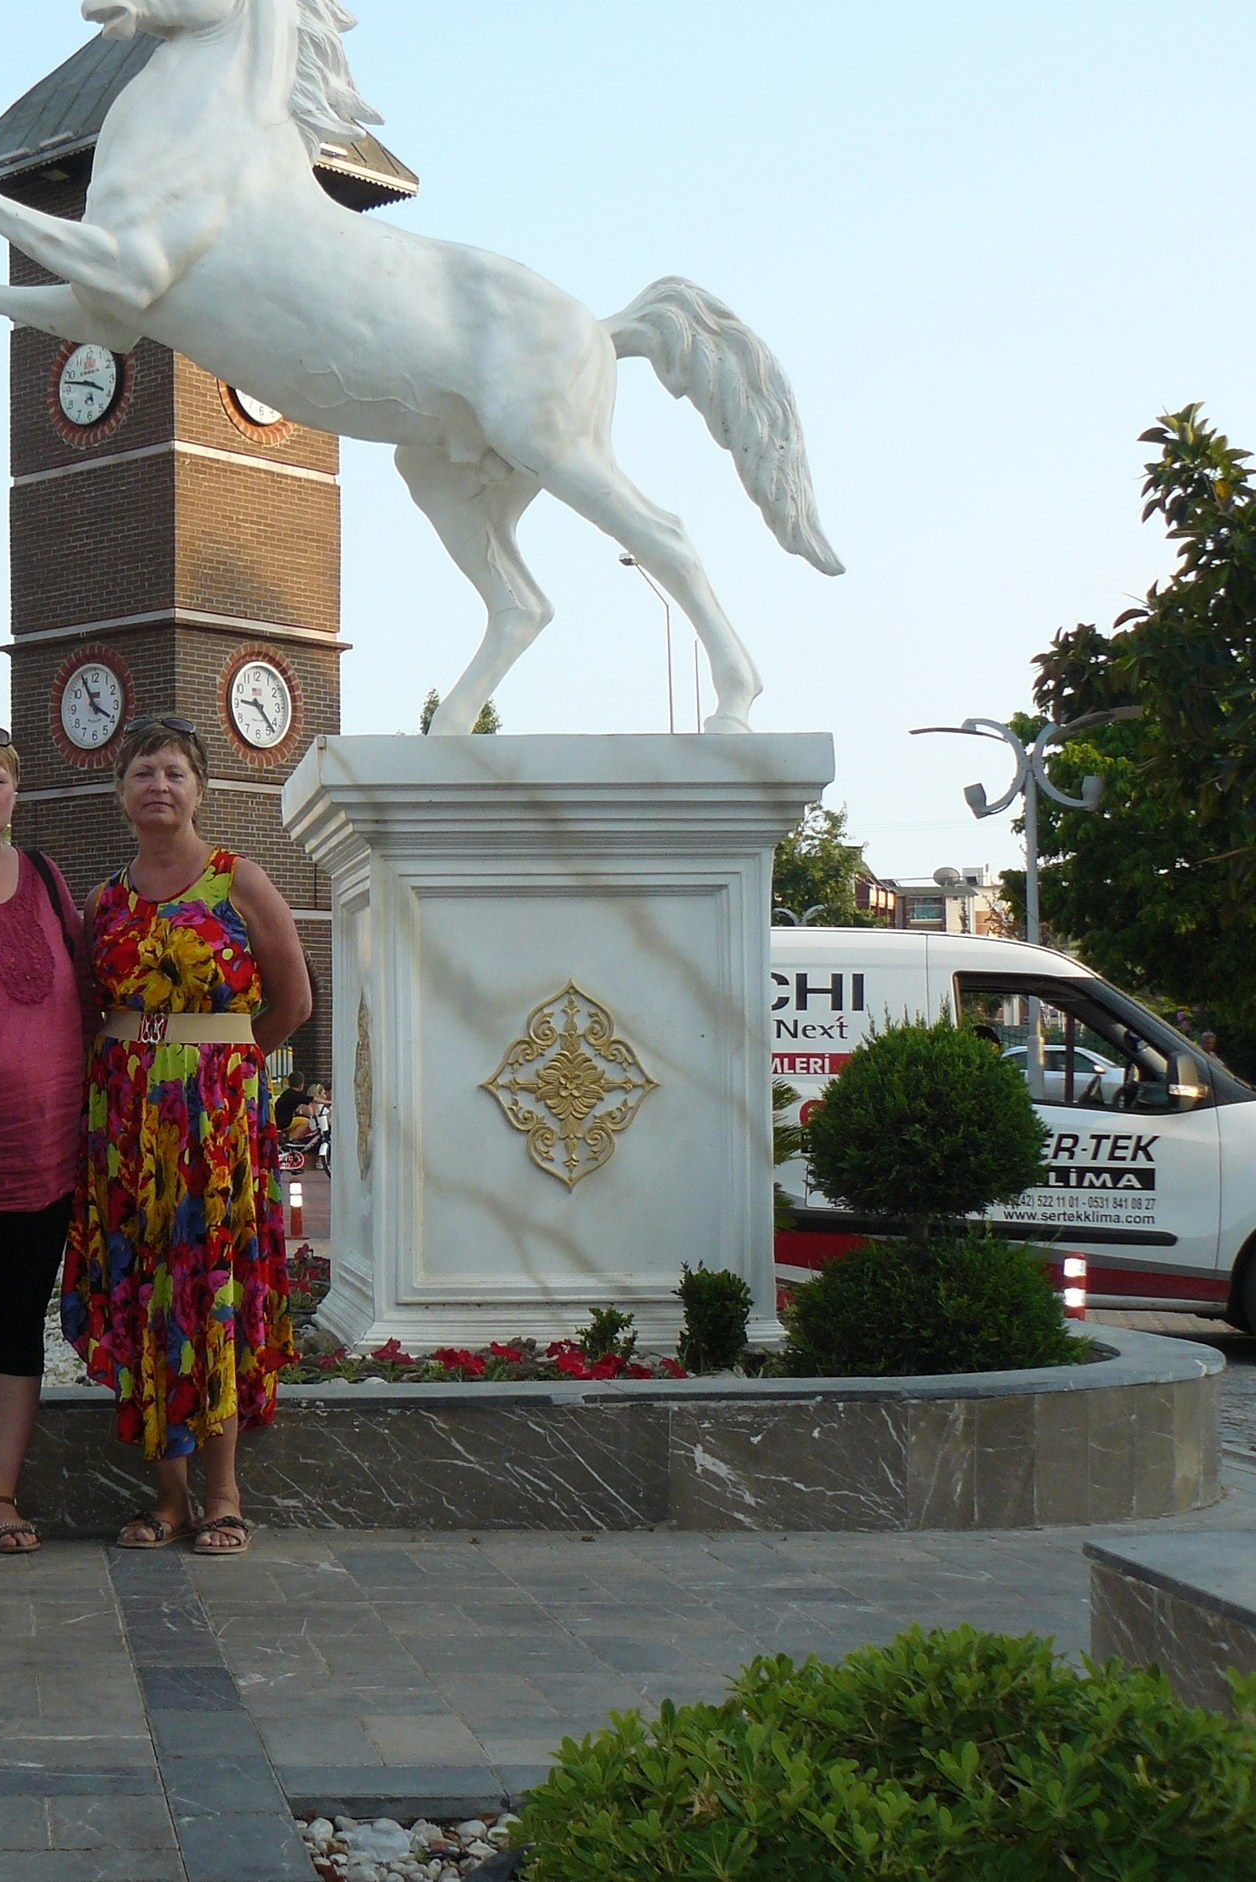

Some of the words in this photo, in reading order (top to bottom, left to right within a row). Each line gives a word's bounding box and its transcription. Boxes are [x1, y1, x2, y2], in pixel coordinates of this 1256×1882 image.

[773, 1016, 849, 1039] Next
[1036, 1168, 1143, 1189] LİMA
[1037, 1195, 1053, 1208] 522
[1057, 1195, 1066, 1208] 11
[1069, 1196, 1079, 1208] 01
[1088, 1196, 1110, 1209] 0531
[1145, 1198, 1156, 1210] 27
[1003, 1210, 1156, 1225] www.sertekklima.com
